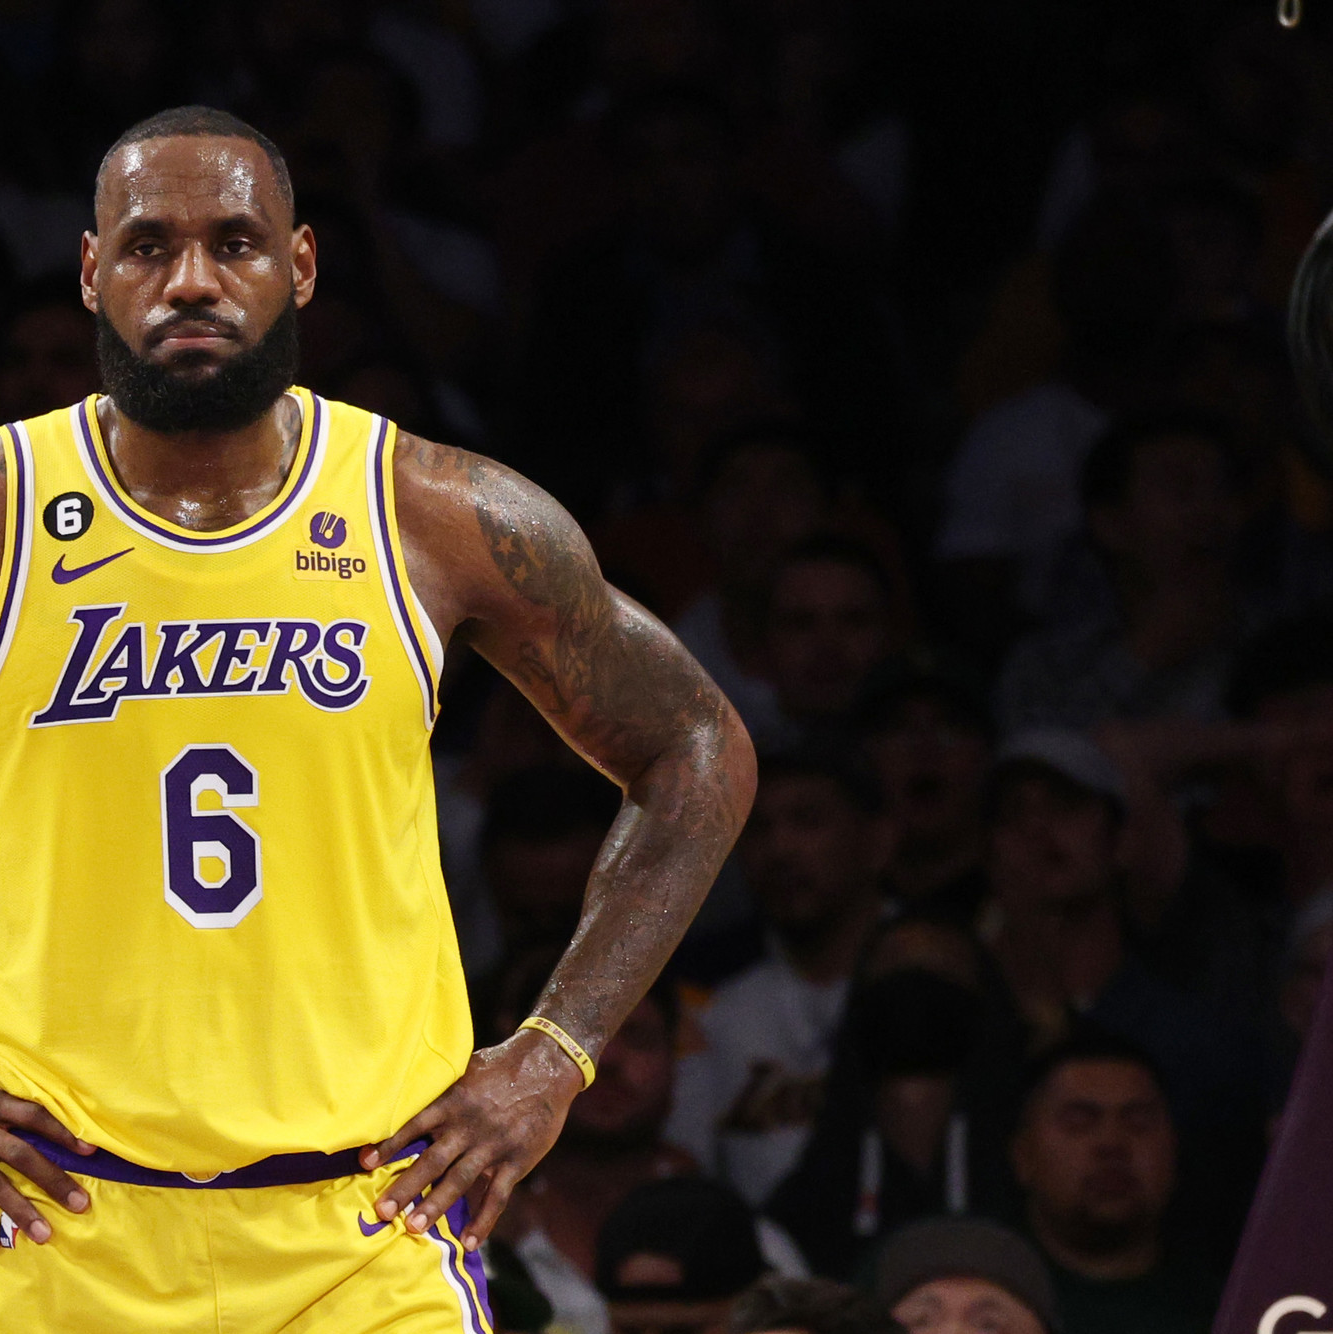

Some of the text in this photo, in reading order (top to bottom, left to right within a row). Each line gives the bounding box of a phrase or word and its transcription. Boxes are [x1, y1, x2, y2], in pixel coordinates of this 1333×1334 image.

[56, 498, 82, 536] 6
[295, 550, 366, 579] bibigo
[28, 602, 371, 728] LAKERS
[159, 743, 263, 929] 6
